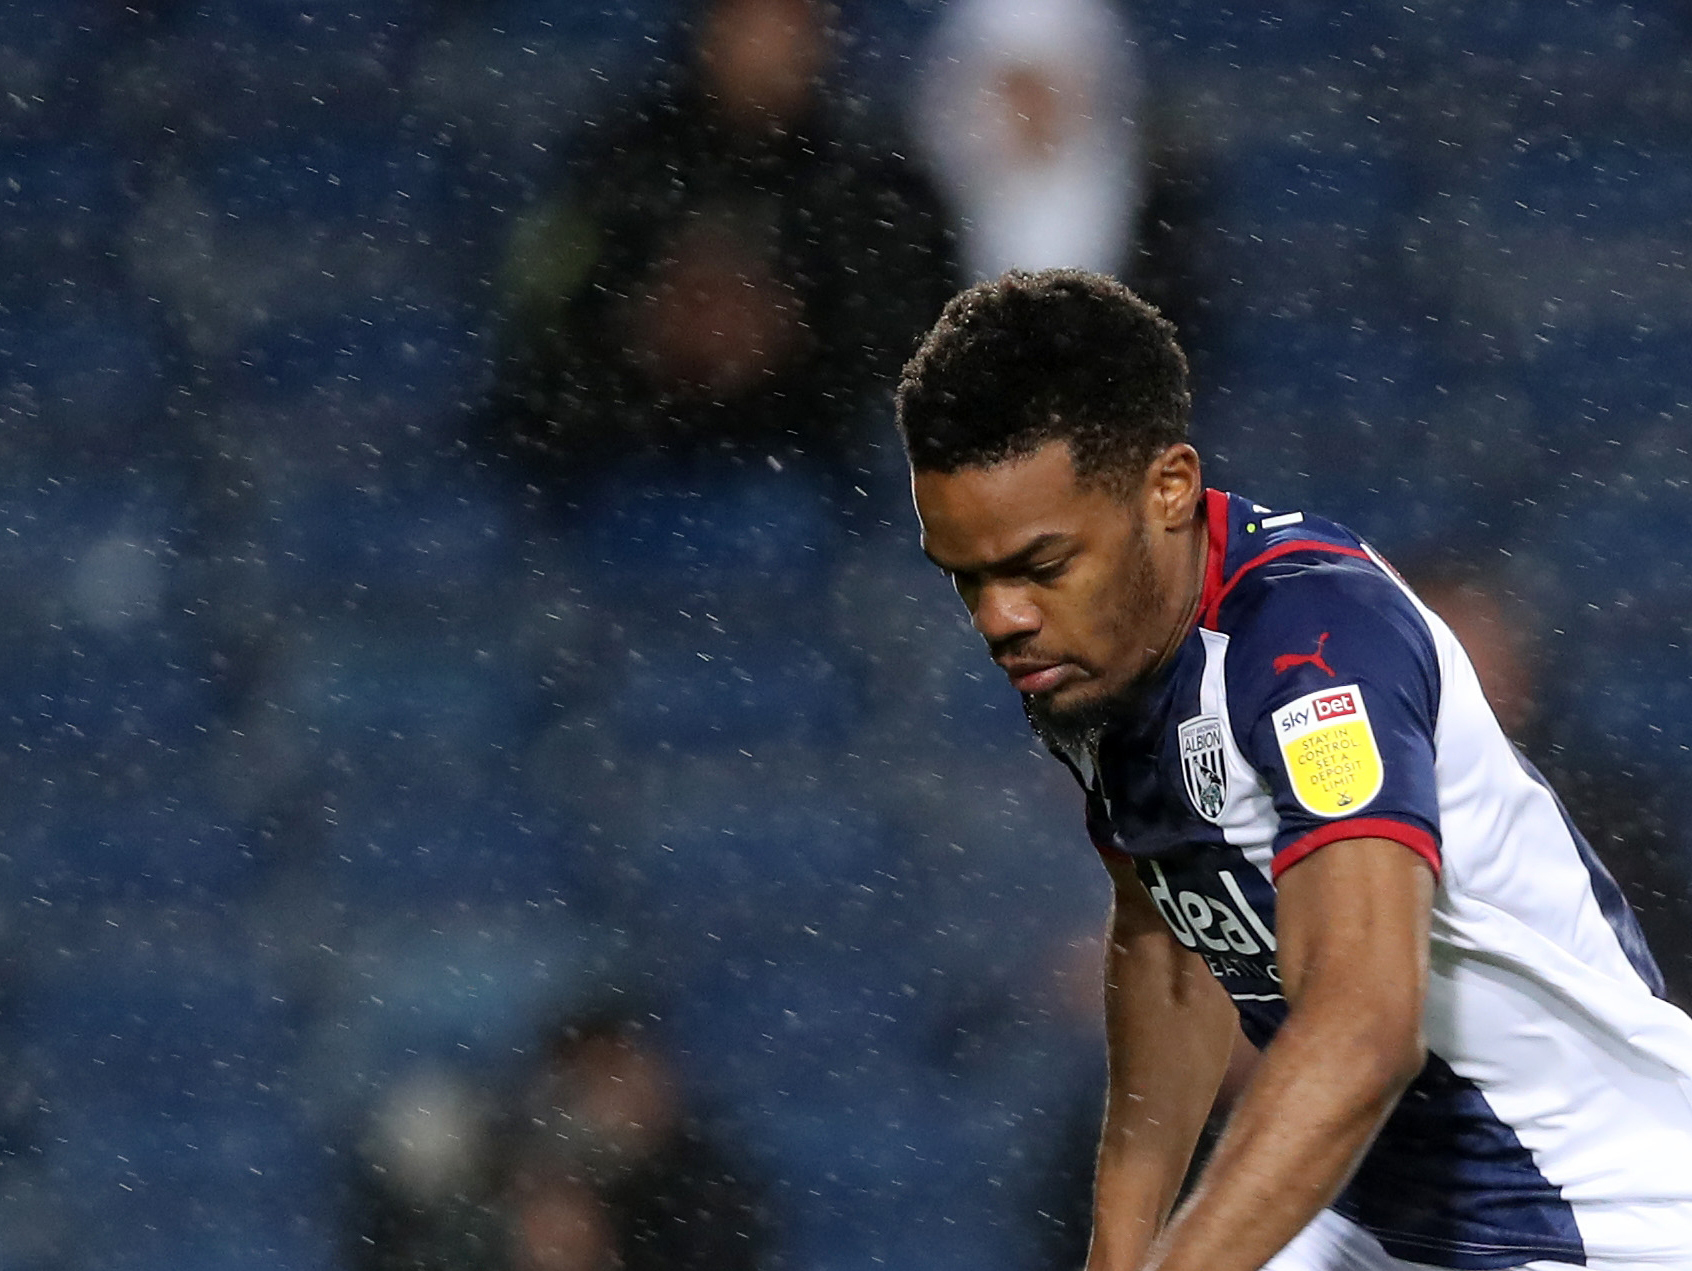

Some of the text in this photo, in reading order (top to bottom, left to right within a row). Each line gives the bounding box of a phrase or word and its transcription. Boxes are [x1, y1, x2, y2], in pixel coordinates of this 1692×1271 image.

[1281, 695, 1353, 732] sky bet
[1185, 730, 1221, 752] ALBION
[1302, 728, 1348, 750] STAY IN
[1310, 760, 1362, 785] DEPOSIT
[1316, 753, 1349, 770] SET A
[1322, 774, 1356, 792] LIMIT
